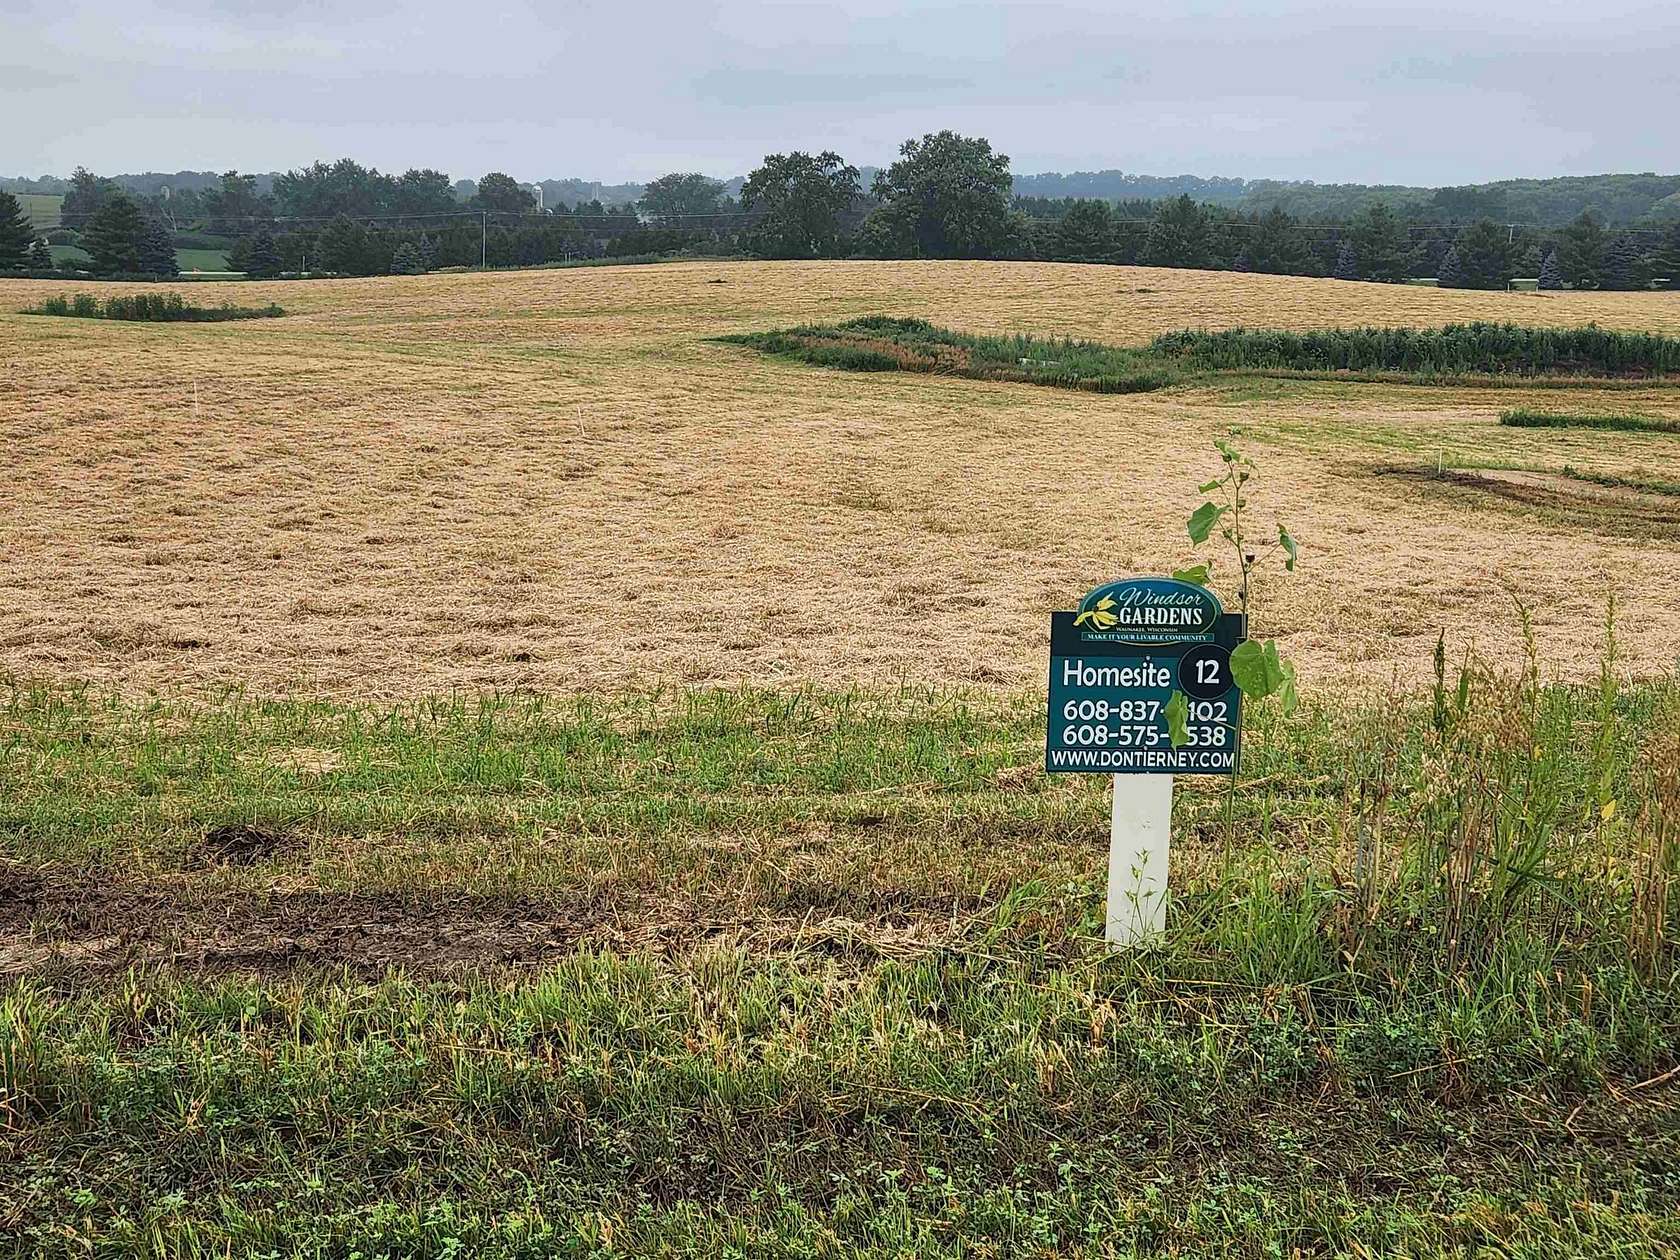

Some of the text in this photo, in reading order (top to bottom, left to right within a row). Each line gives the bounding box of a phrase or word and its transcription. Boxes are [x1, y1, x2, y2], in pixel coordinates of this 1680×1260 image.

[1120, 587, 1204, 606] Windsor
[1120, 607, 1202, 625] GARDENS
[1063, 659, 1220, 687] Homesite 12
[1063, 700, 1227, 722] 608-837-102
[1062, 724, 1226, 746] 608-575-538
[1051, 750, 1235, 768] WWW.DONTIERNEY.COM
